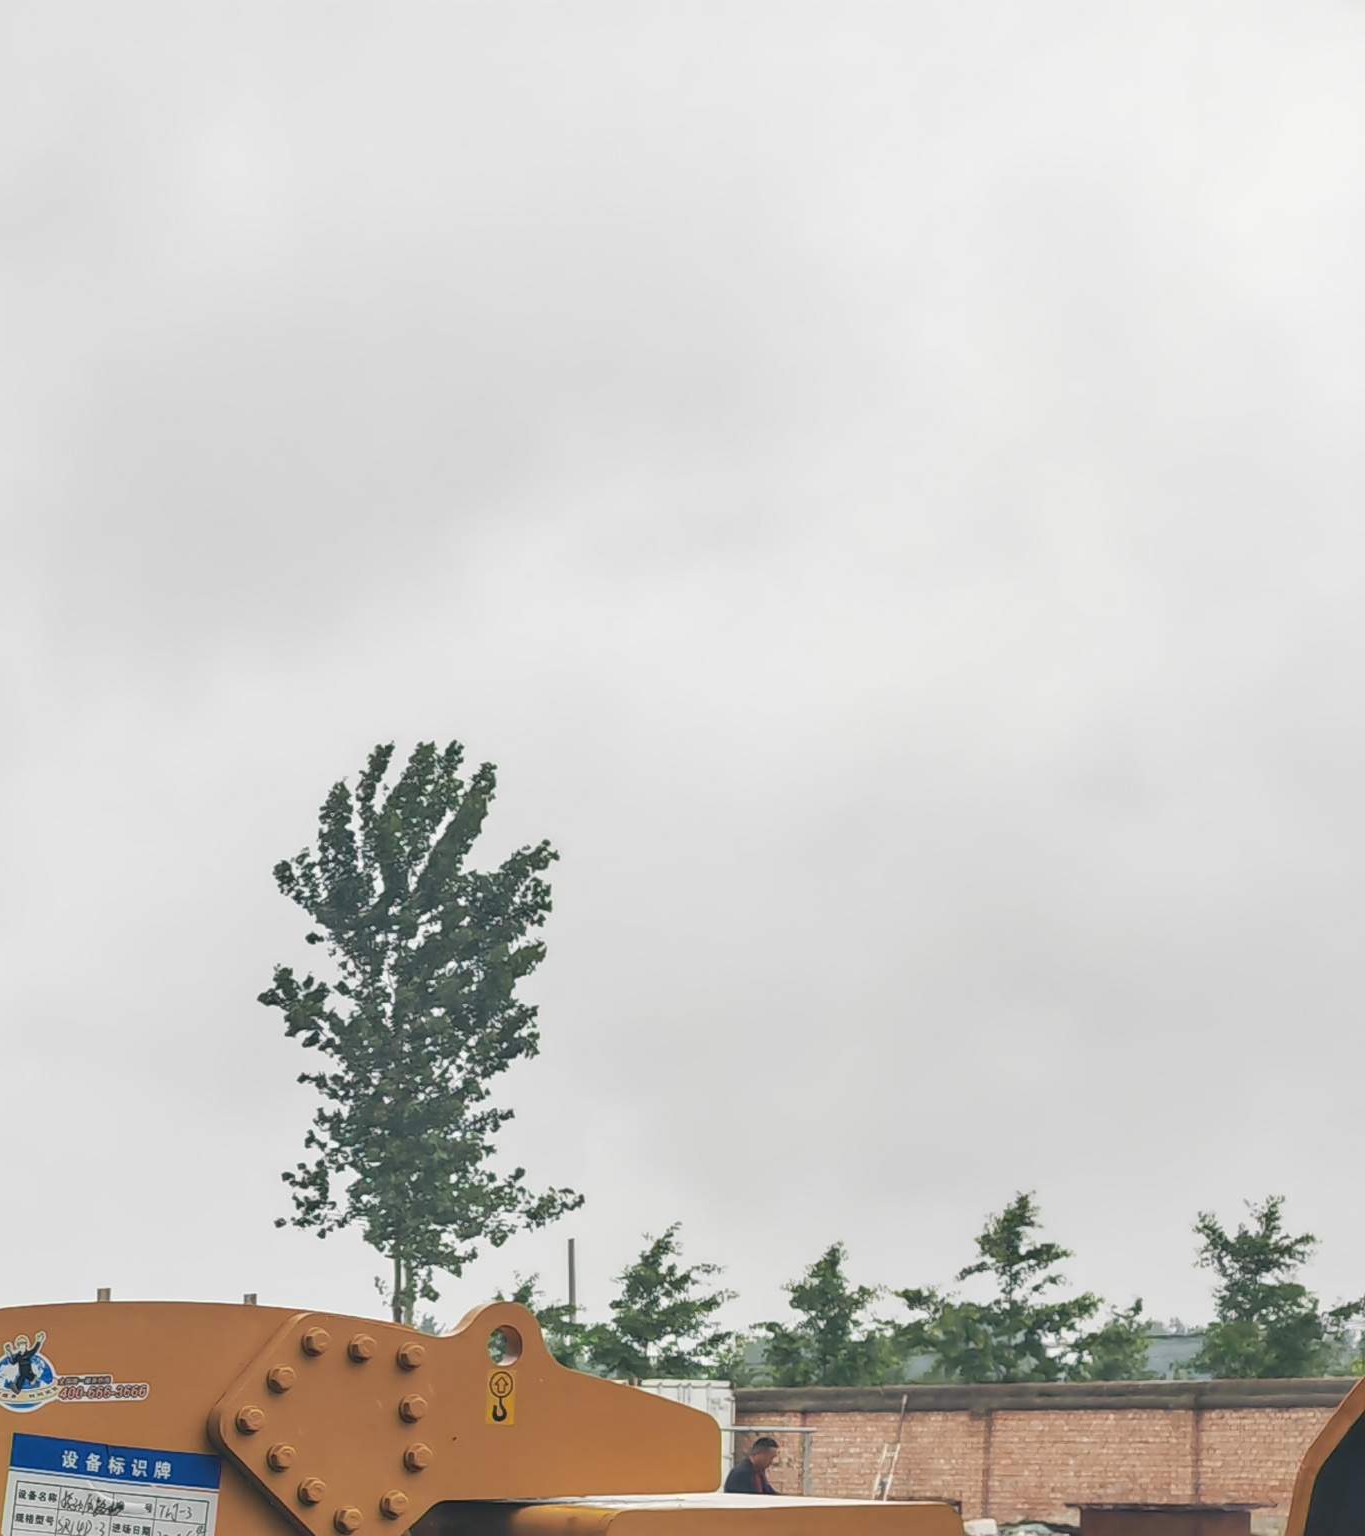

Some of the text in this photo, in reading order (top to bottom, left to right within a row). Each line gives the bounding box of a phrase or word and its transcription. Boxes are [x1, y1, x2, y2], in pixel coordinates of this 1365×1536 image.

[61, 1450, 173, 1480] 设备标识牌
[17, 1488, 58, 1503] 设备名称
[14, 1512, 55, 1527] 规格型号
[111, 1522, 152, 1536] 进场日期
